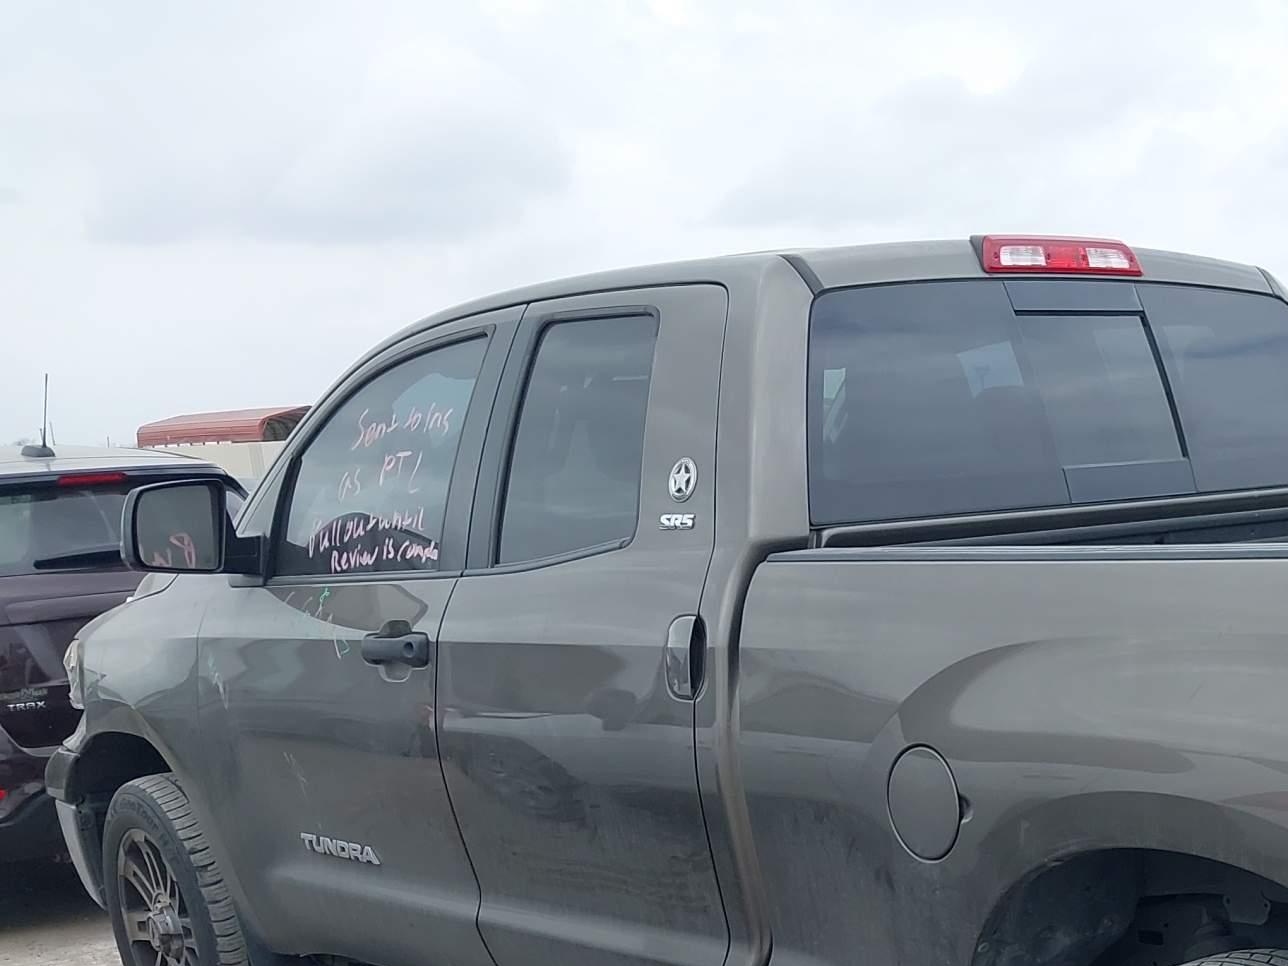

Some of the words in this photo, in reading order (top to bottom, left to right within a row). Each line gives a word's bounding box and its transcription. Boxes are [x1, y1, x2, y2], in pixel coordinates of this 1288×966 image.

[351, 408, 399, 450] Sent
[659, 513, 696, 529] SR5
[7, 700, 47, 712] TRAX
[300, 832, 381, 865] TUNDRA
